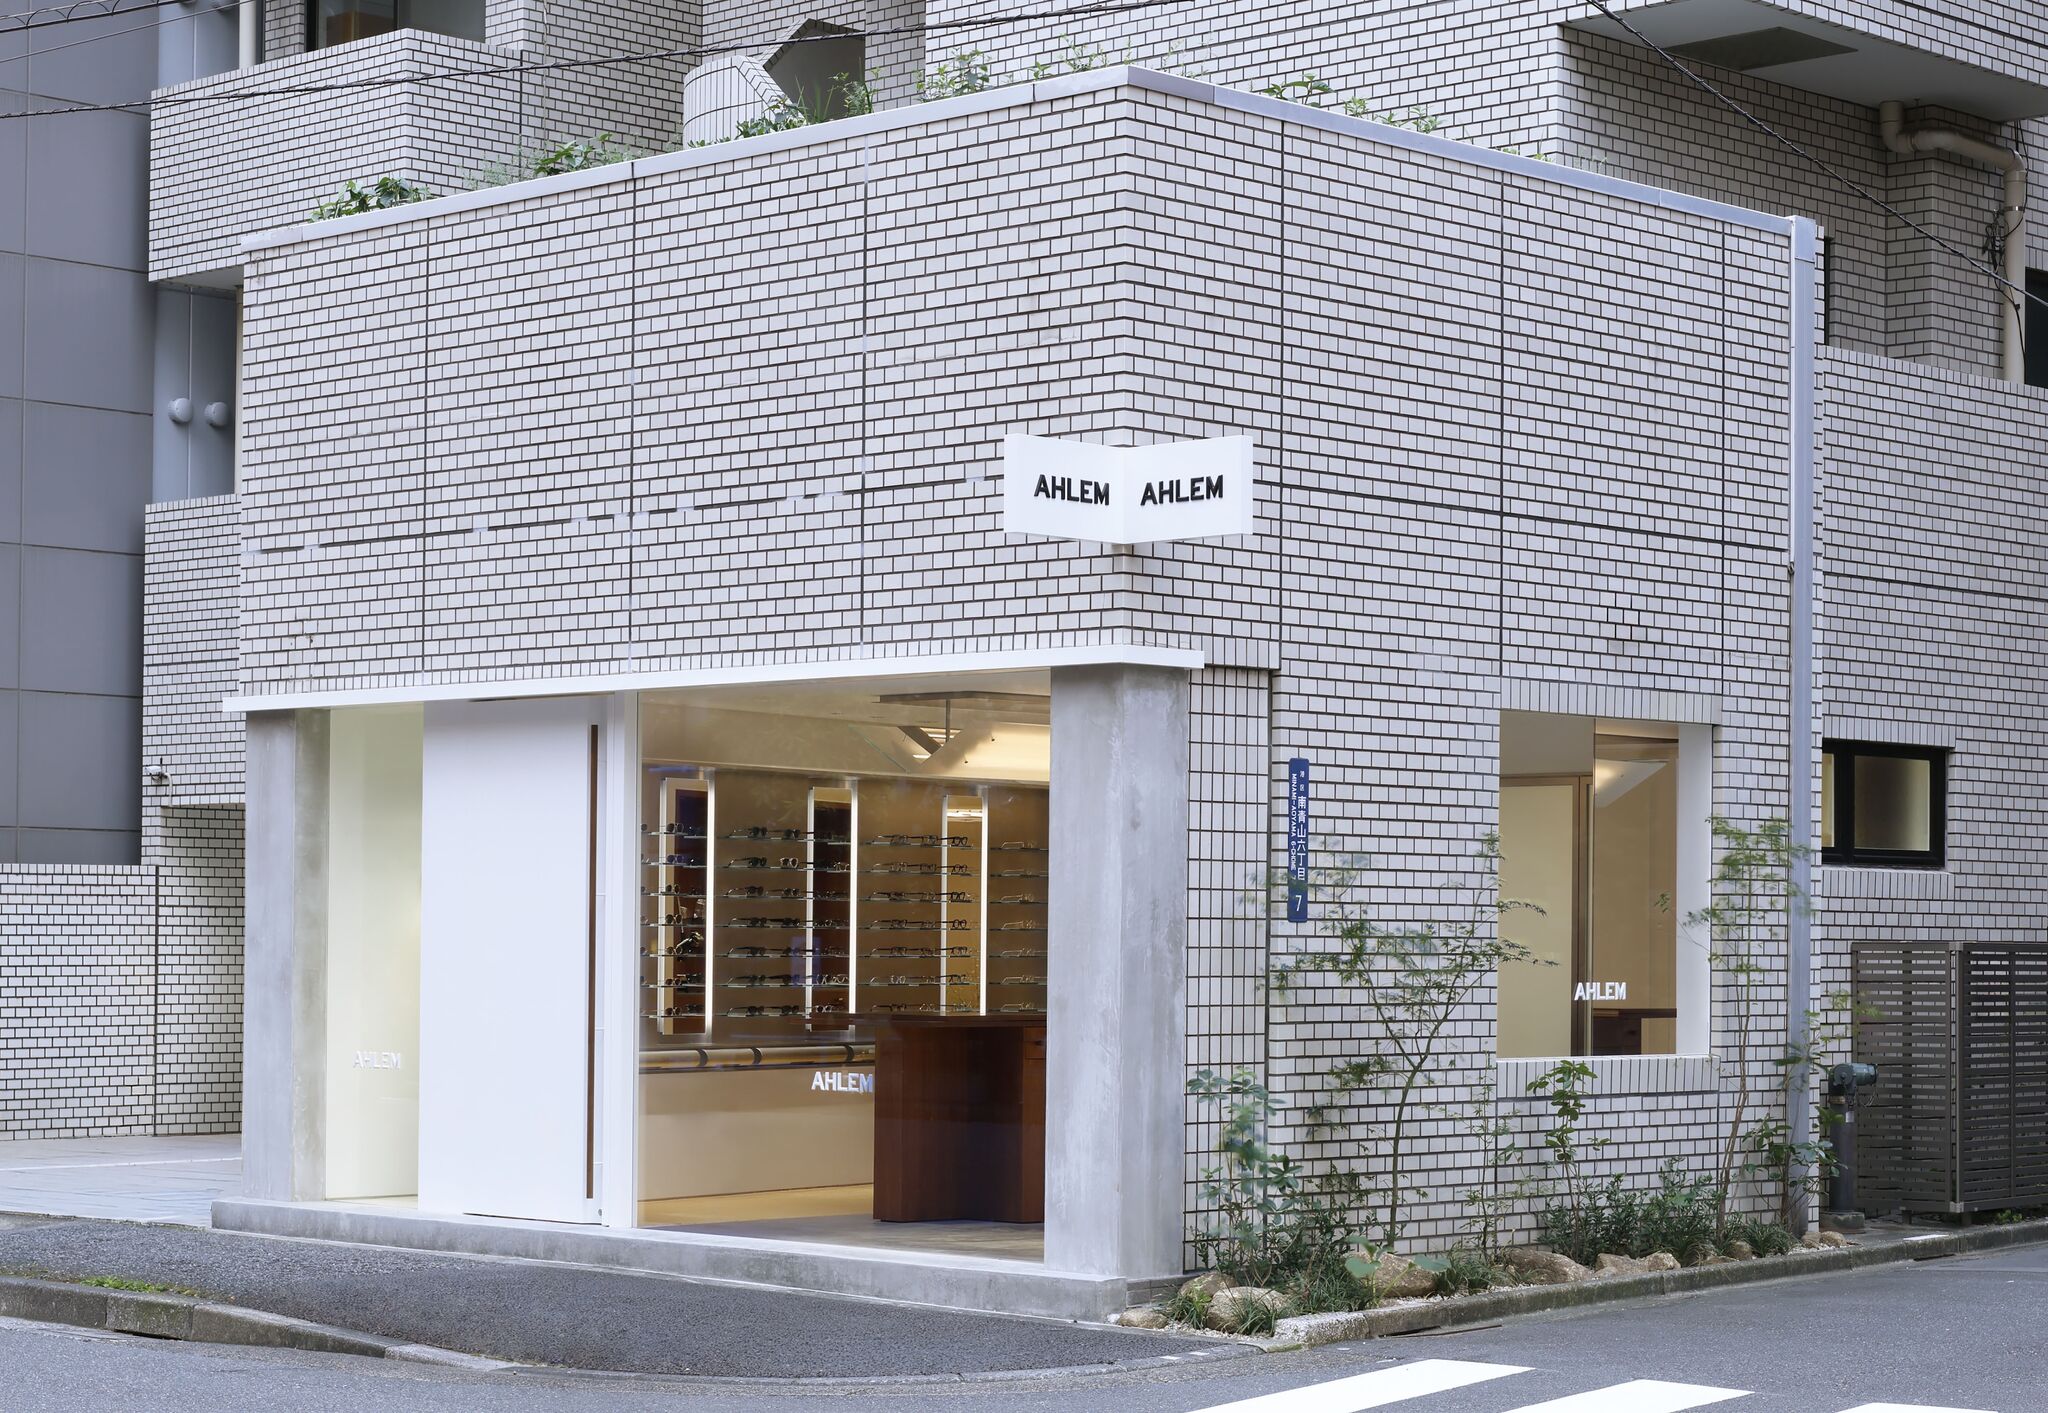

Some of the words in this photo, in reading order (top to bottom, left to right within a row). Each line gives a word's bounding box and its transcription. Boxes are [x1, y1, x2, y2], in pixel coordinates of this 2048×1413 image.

[1034, 474, 1110, 506] AHLEM
[1140, 475, 1224, 506] AHLEM
[1295, 894, 1302, 912] 7
[1574, 982, 1627, 1001] AHLEM
[353, 1050, 401, 1070] AHLEM
[811, 1071, 873, 1093] AHLEM
